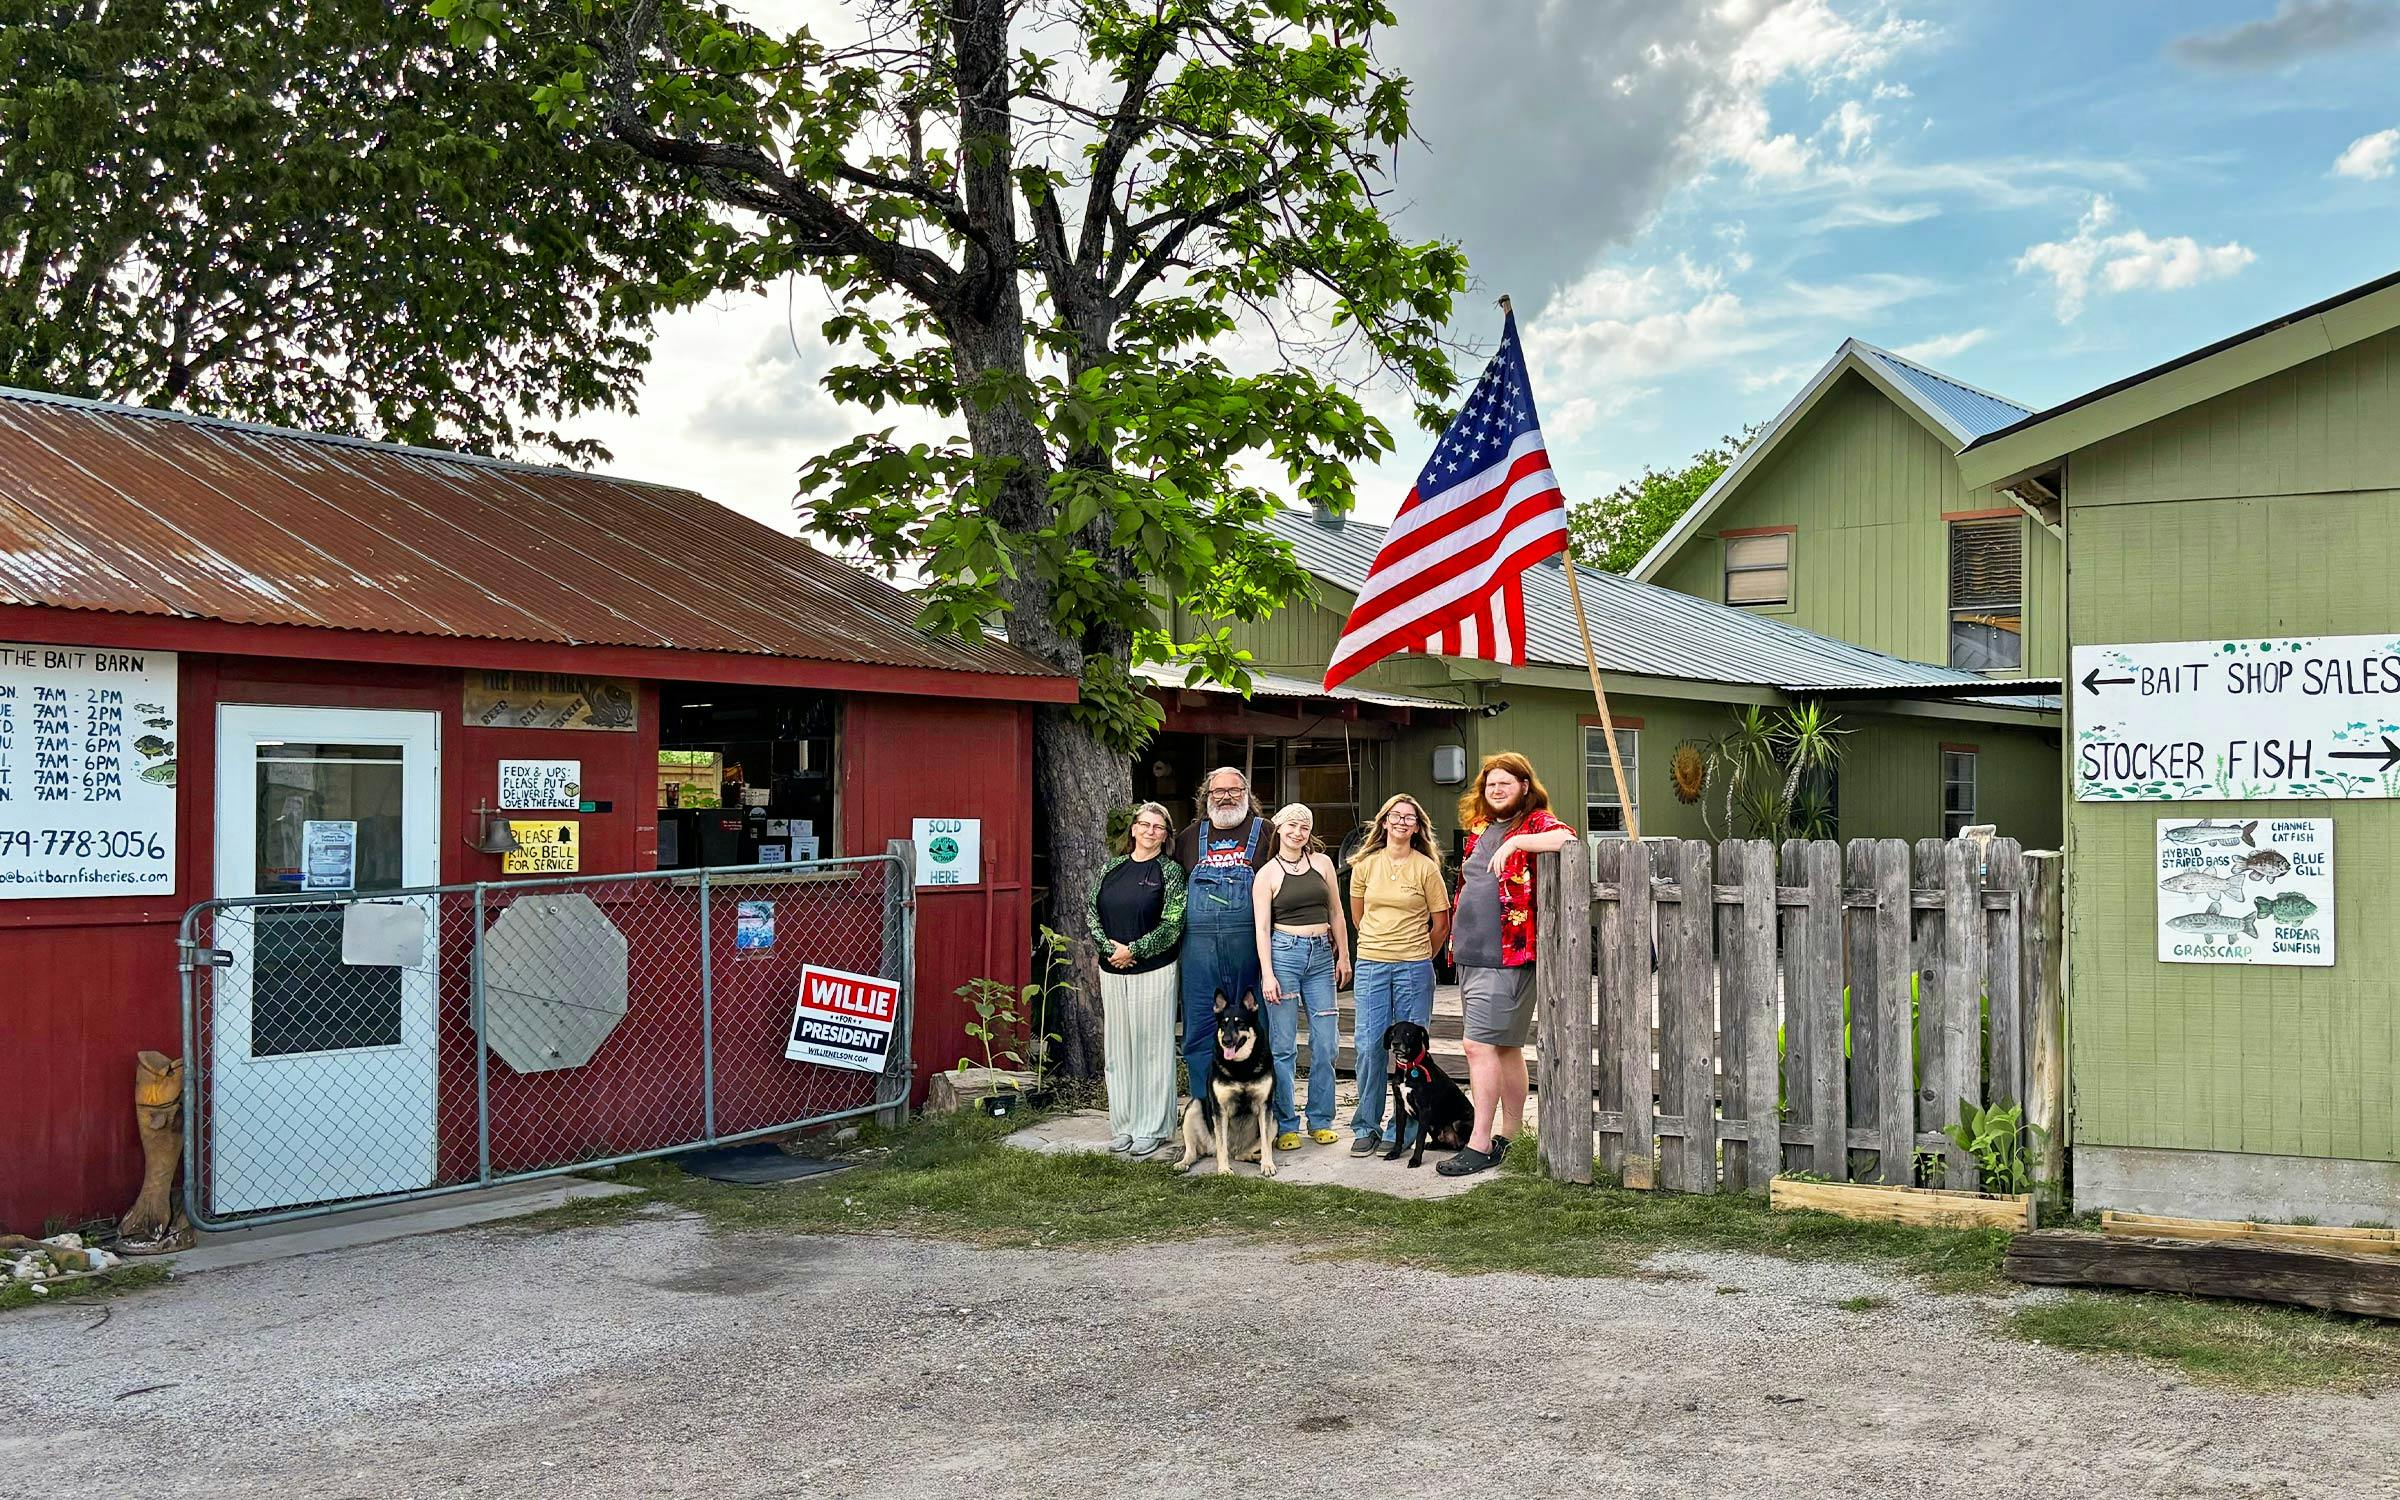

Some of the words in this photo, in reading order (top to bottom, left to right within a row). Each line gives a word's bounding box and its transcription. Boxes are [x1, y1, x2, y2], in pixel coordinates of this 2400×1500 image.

[0, 649, 37, 668] THE
[45, 651, 86, 669] BAIT
[96, 653, 144, 672] BARN
[2142, 664, 2208, 695] BAIT
[2227, 660, 2293, 694] SHOP
[2302, 656, 2400, 695] SALES
[34, 687, 66, 701] 7AM
[34, 704, 67, 718] 7AM
[34, 720, 69, 734] 7AM
[35, 737, 69, 751] 7AM
[36, 753, 69, 769] 7AM
[2082, 742, 2204, 780] STOCKER
[2229, 739, 2312, 780] FISH
[34, 770, 69, 785] 7AM
[504, 766, 531, 777] FEDX
[504, 777, 538, 789] PLEASE
[544, 778, 566, 789] PUT
[34, 786, 68, 801] 7AM
[503, 789, 555, 800] DELIVERIES
[505, 800, 530, 809] OVER
[929, 820, 962, 833] SOLD
[2271, 822, 2315, 831] CHANNEL
[542, 846, 574, 858] BELL
[2162, 848, 2202, 858] HYBRID
[2293, 852, 2325, 864] BLUE
[508, 860, 529, 871] FOR
[533, 859, 573, 871] SERVICE
[2162, 857, 2204, 868] STRIPED
[2206, 856, 2230, 867] BASS
[930, 870, 959, 884] HERE
[2295, 865, 2326, 876] GILL
[2275, 927, 2320, 940] REDEAR
[2272, 941, 2321, 954] SUNFISH
[811, 978, 890, 1016] WILLIE
[840, 1015, 853, 1023] FOR
[801, 1020, 883, 1049] PRESIDENT
[808, 1046, 868, 1063] WILLIENELSON.COM
